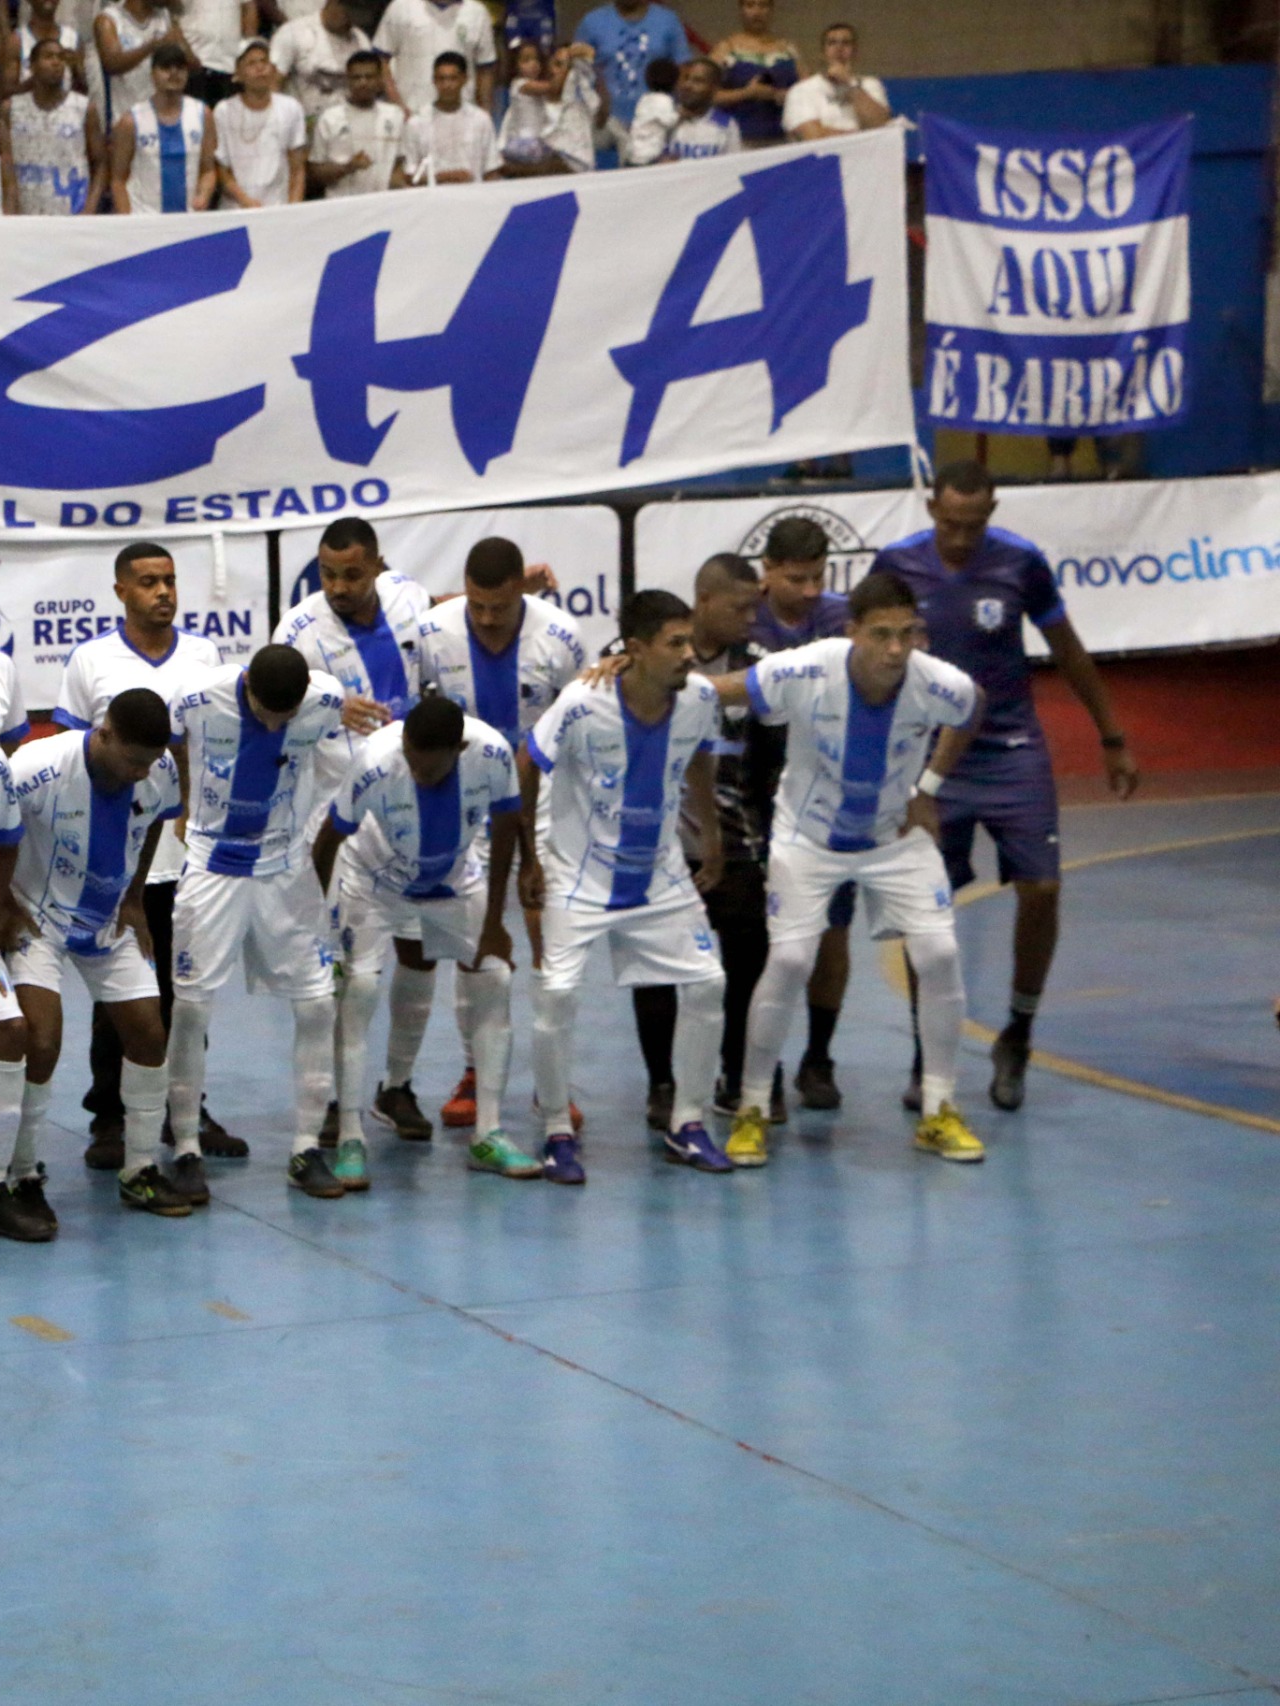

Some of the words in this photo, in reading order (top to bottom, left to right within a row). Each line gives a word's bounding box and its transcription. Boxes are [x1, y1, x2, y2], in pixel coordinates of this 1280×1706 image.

[975, 143, 1136, 222] ISSO
[987, 242, 1141, 319] AQUI
[928, 330, 961, 420] É
[972, 335, 1184, 428] BARRÃO
[61, 500, 141, 527] DO
[166, 478, 391, 524] ESTADO
[1057, 535, 1280, 588] novoclim
[33, 598, 96, 615] GRUPO
